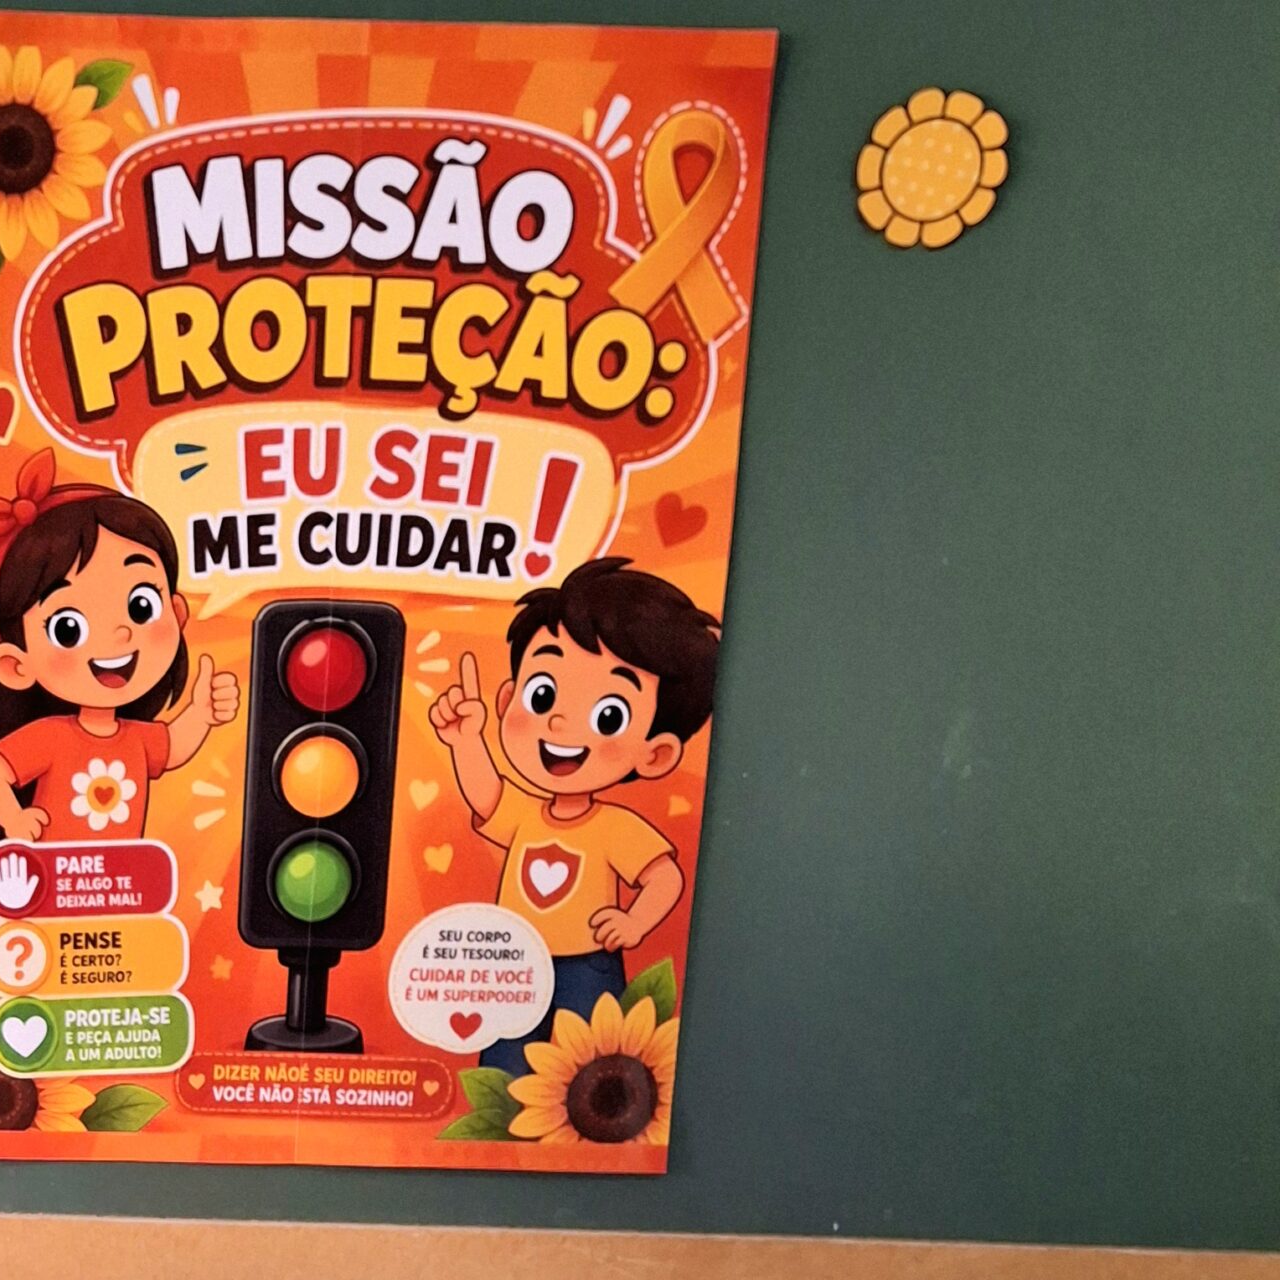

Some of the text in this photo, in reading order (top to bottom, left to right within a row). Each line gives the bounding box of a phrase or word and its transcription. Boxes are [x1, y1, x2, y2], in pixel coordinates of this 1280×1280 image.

[150, 139, 575, 273] MISSÃO
[61, 273, 689, 420] PROTEÇÃO:
[243, 426, 497, 507] EU SEI
[192, 516, 280, 576] ME
[55, 855, 105, 875] PARE
[56, 876, 132, 892] SE ALGO TE
[56, 893, 142, 909] DEIXAR MAL!
[59, 931, 122, 950] PENSE
[439, 930, 512, 943] SEU CORPO
[60, 953, 122, 968] É CERTO?
[422, 944, 525, 961] É SEU TESOURO!
[60, 970, 133, 985] É SEGURO?
[409, 968, 466, 983] CUIDAR
[470, 970, 490, 983] DE
[404, 986, 537, 1004] É UM SUPERPODER!
[64, 1007, 171, 1028] PROTEJA-SE
[65, 1029, 161, 1047] E PEÇA AJUDA
[65, 1046, 162, 1061] A UM ADULTO!
[213, 1065, 417, 1087] DIZER SEU DIREITO!
[212, 1083, 414, 1107] VOCÊ NÃO SOZINHO!
